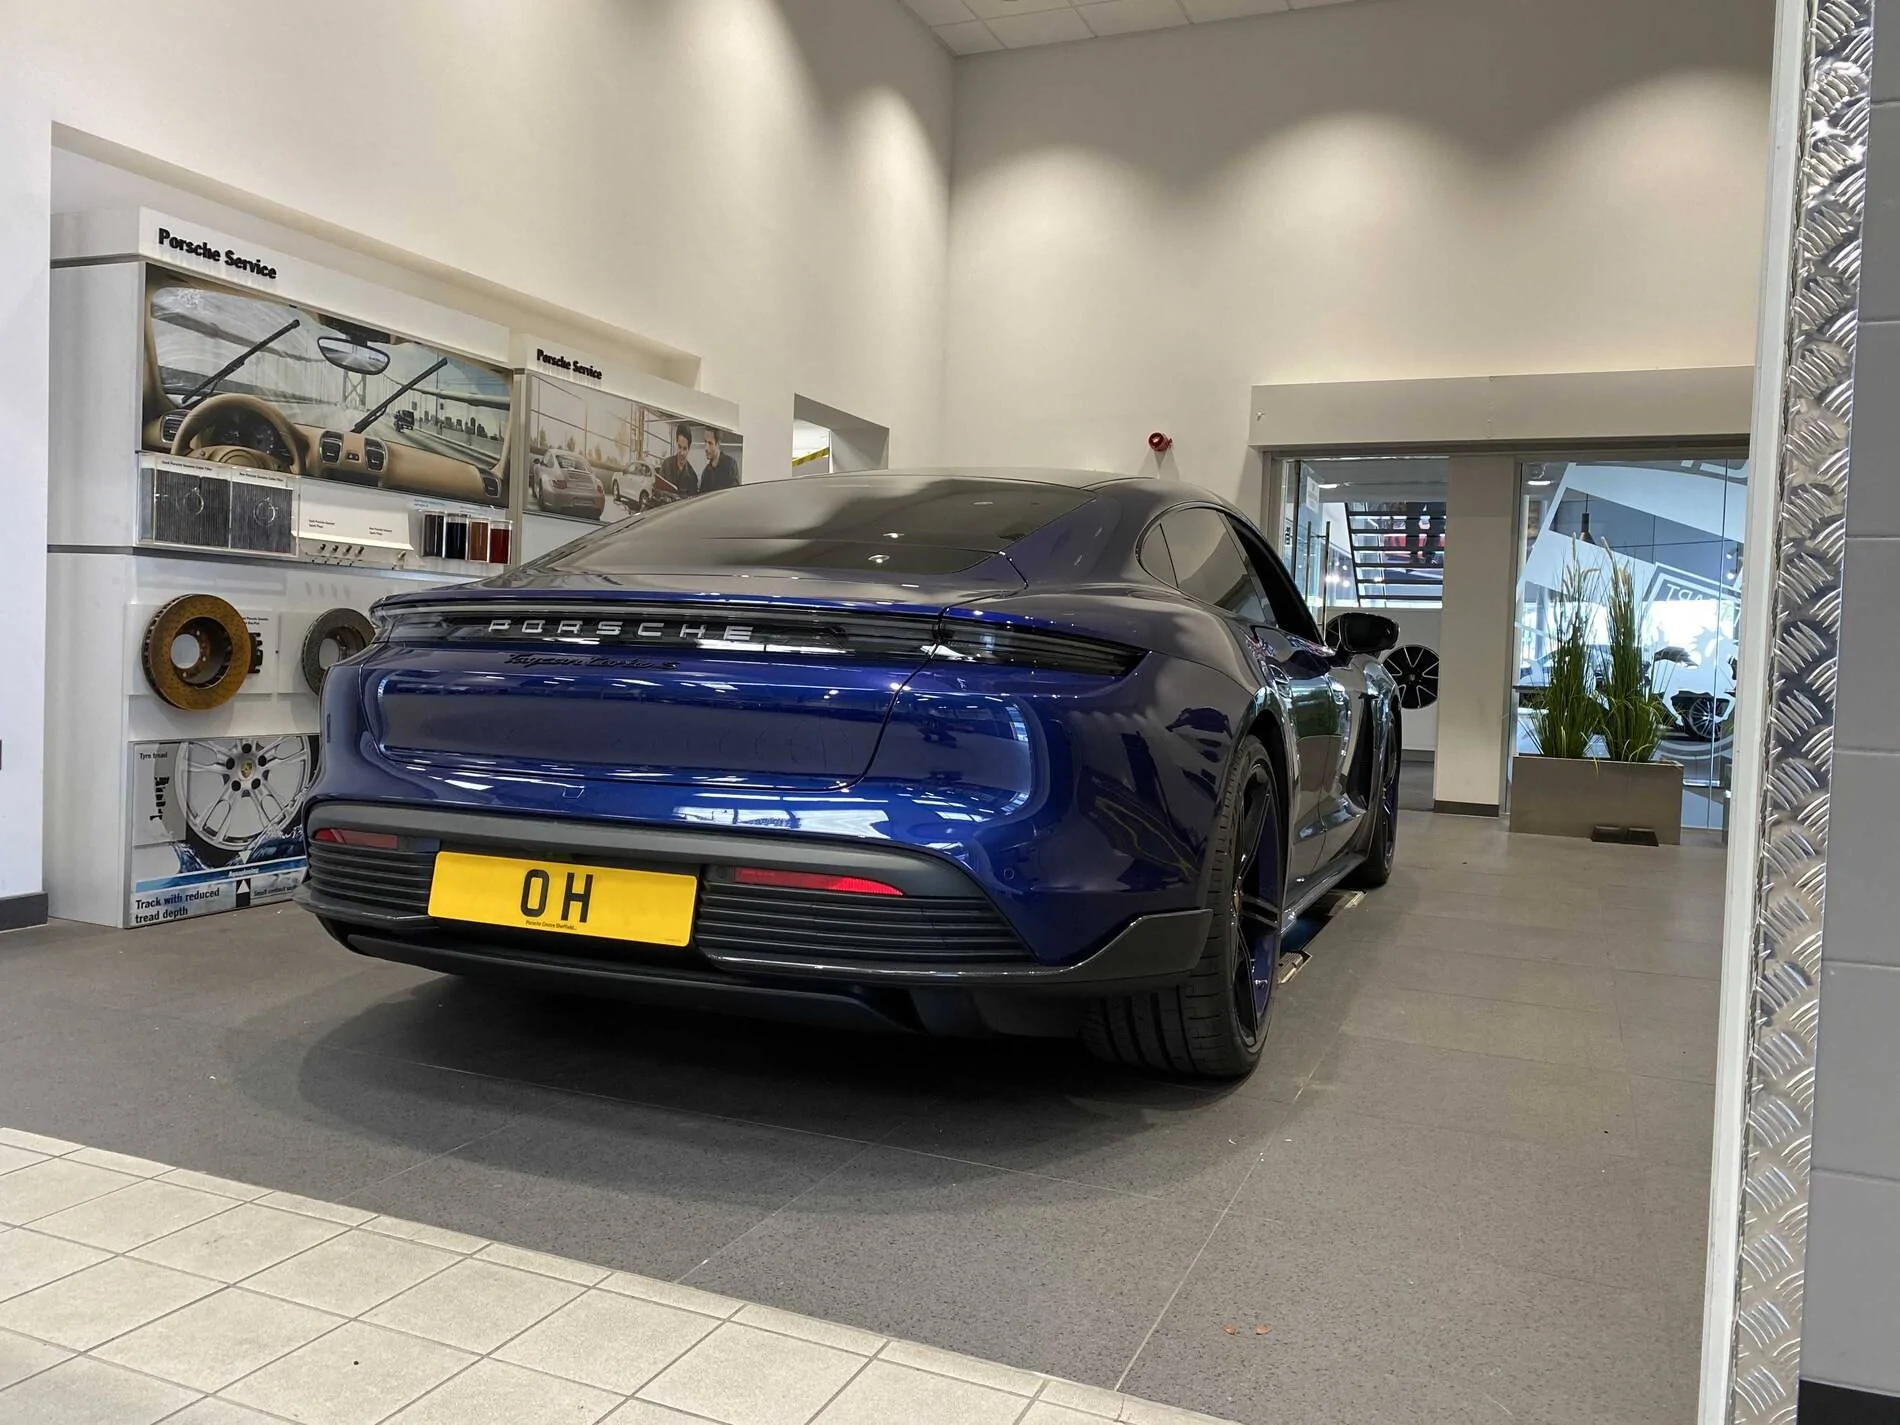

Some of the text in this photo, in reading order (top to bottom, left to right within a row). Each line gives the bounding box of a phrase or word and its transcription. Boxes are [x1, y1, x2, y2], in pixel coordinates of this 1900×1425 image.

[158, 227, 277, 279] Porsche Service
[537, 348, 602, 380] Porsche Service
[488, 619, 753, 641] PORSCHE
[136, 887, 220, 910] Track with reduced
[135, 905, 188, 924] tread depth
